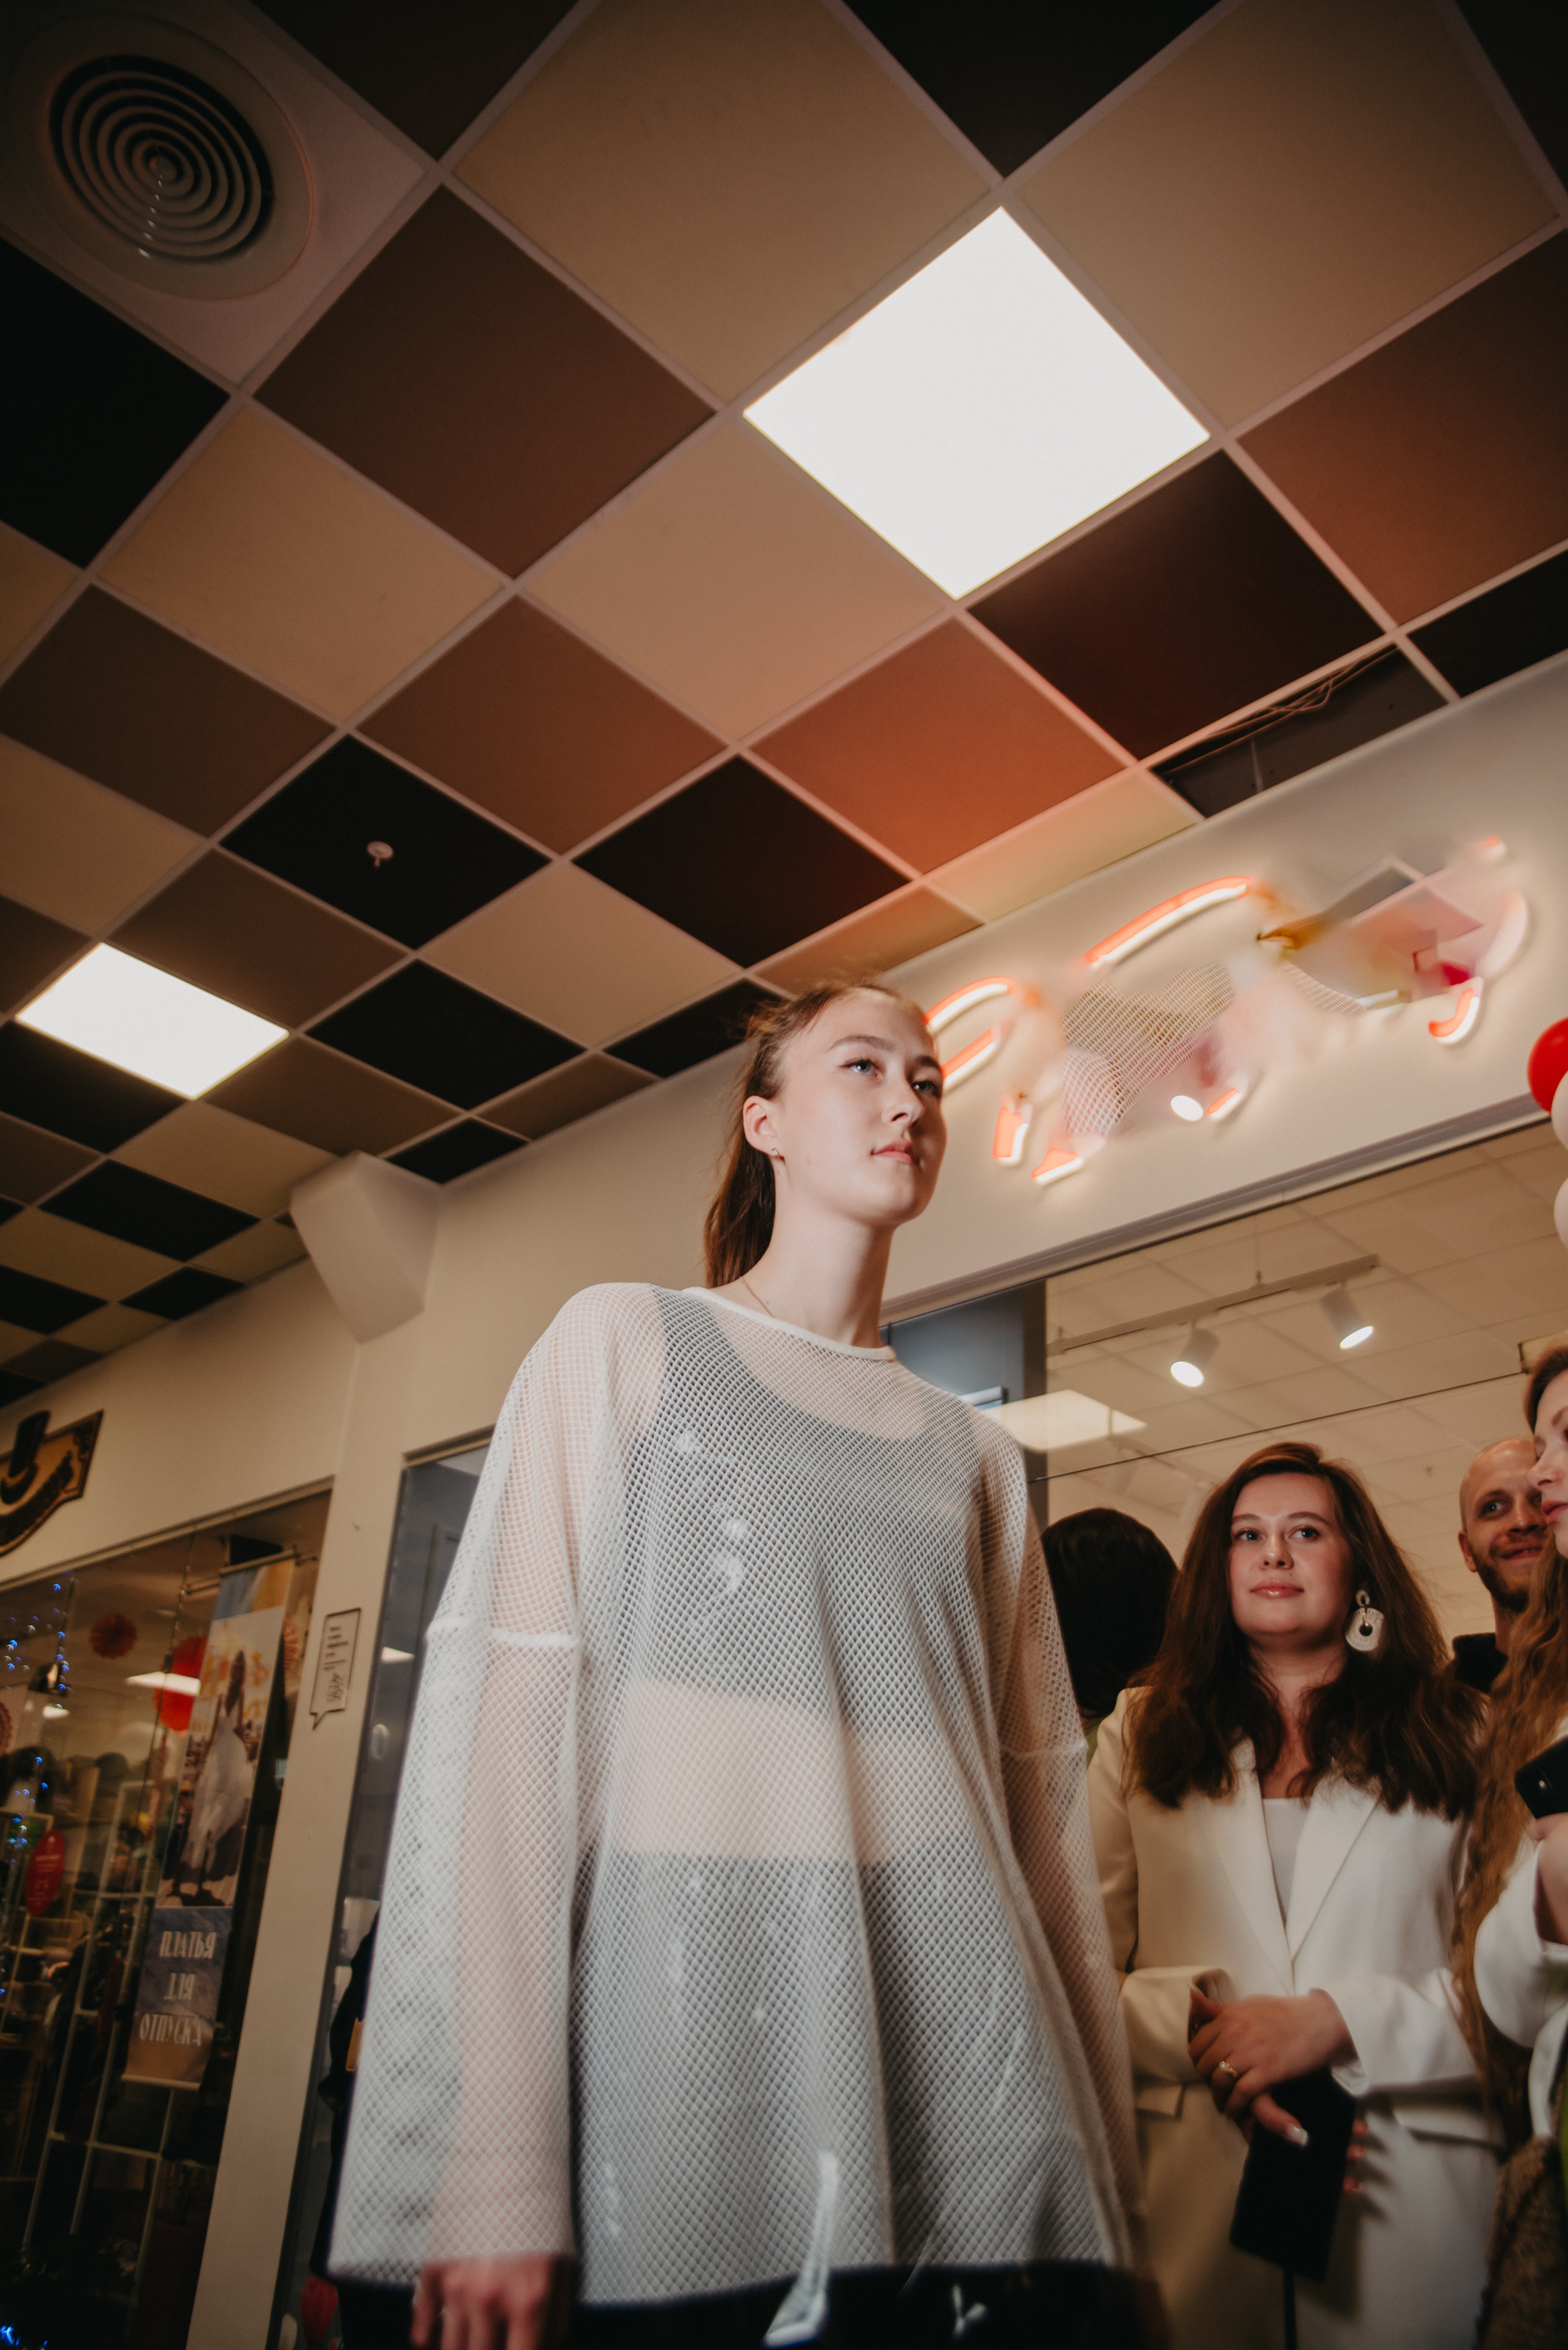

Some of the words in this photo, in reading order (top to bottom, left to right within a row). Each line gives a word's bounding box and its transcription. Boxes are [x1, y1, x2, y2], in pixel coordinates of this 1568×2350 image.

[158, 1930, 218, 1959] ПЛАТЬЯ
[163, 1972, 197, 2001] ДЛЯ
[139, 2013, 201, 2047] ОТПУСКА
